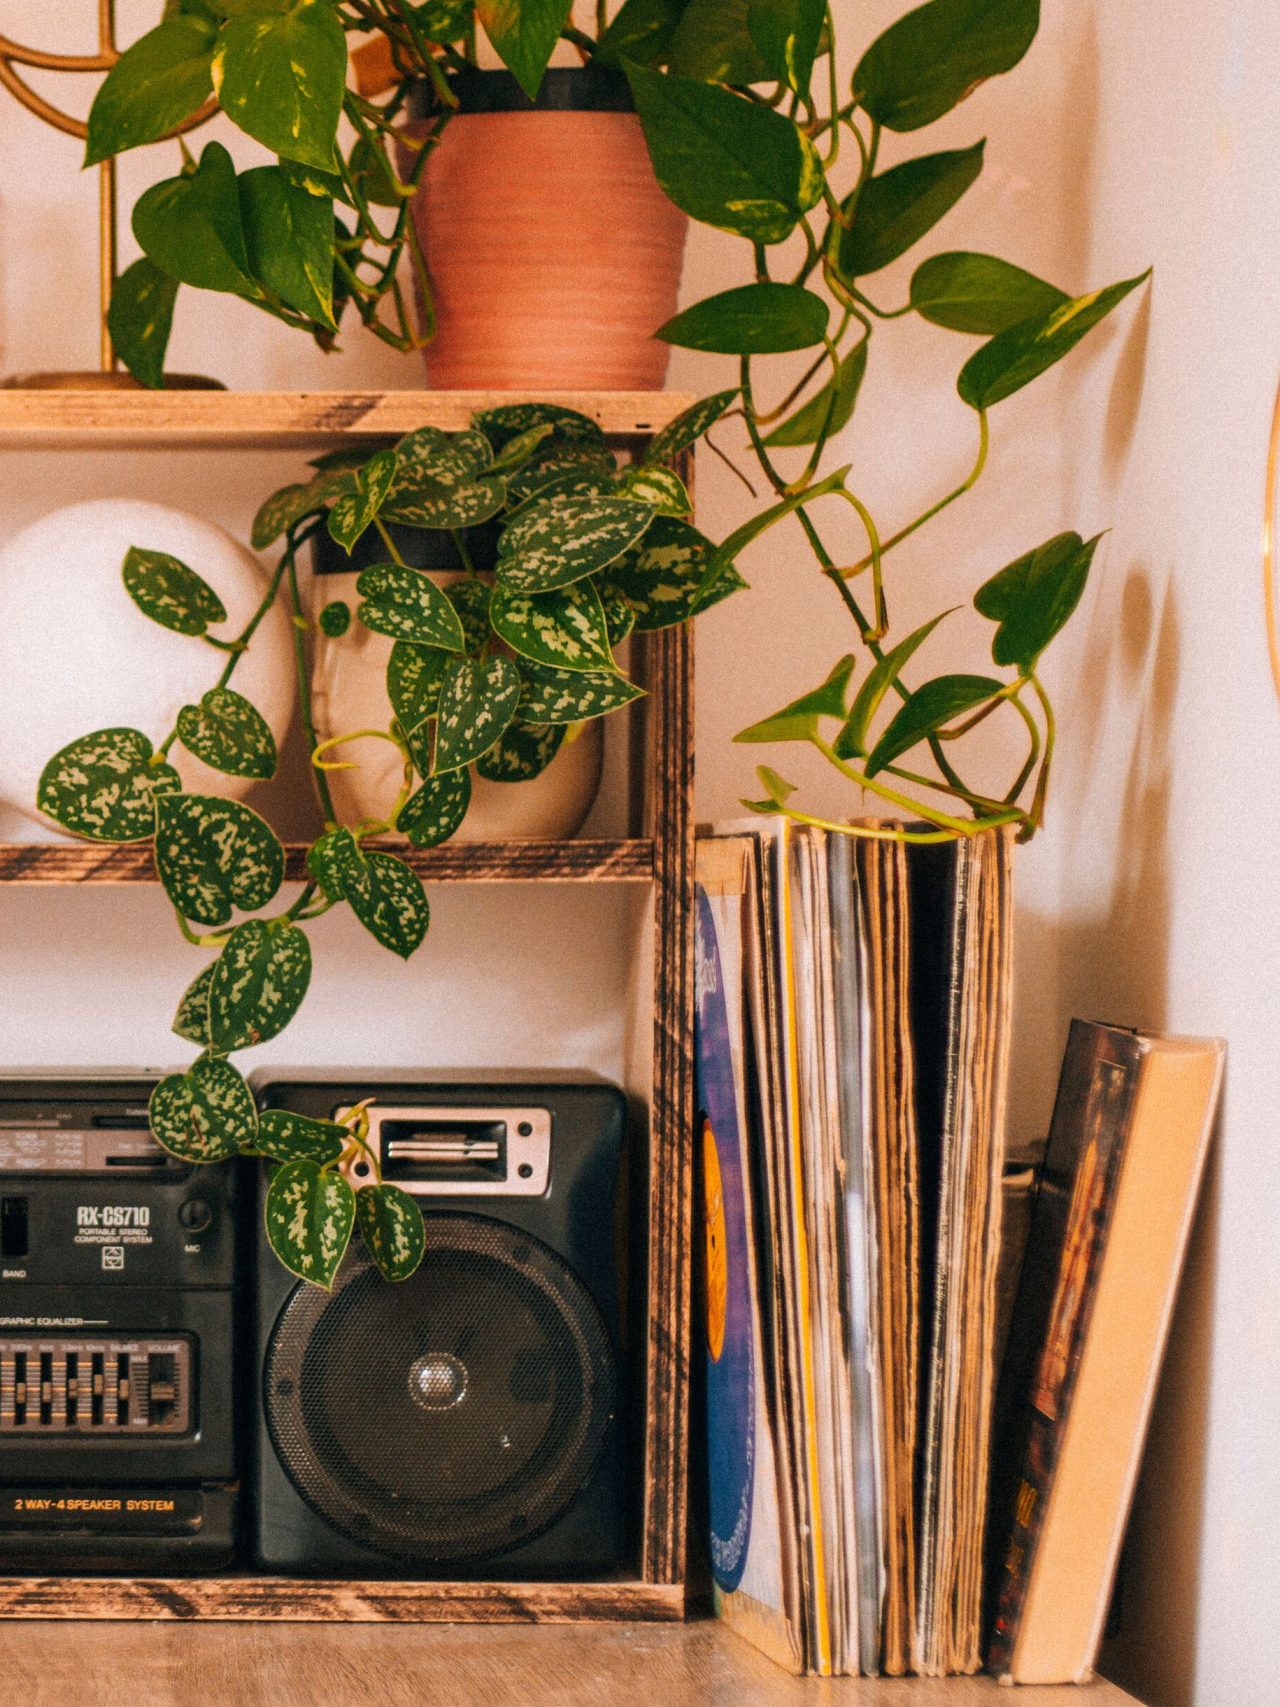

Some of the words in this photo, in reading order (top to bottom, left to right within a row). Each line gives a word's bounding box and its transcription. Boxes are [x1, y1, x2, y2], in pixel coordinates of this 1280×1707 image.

[77, 1206, 150, 1226] RX-CS710
[79, 1228, 116, 1236] PORTABLE
[118, 1228, 148, 1236] STEREO
[74, 1236, 121, 1244] COMPONENT
[122, 1236, 153, 1244] SYSTEM
[184, 1244, 200, 1252] MIC
[3, 1269, 26, 1278] BAND
[0, 1317, 35, 1326] GRAPHIC
[37, 1317, 83, 1326] EQUALIZER
[148, 1343, 181, 1352] VOLUME
[15, 1499, 23, 1510] 2
[25, 1499, 66, 1510] WAY-4
[67, 1499, 121, 1510] SPEAKER
[126, 1500, 174, 1511] SYSTEM
